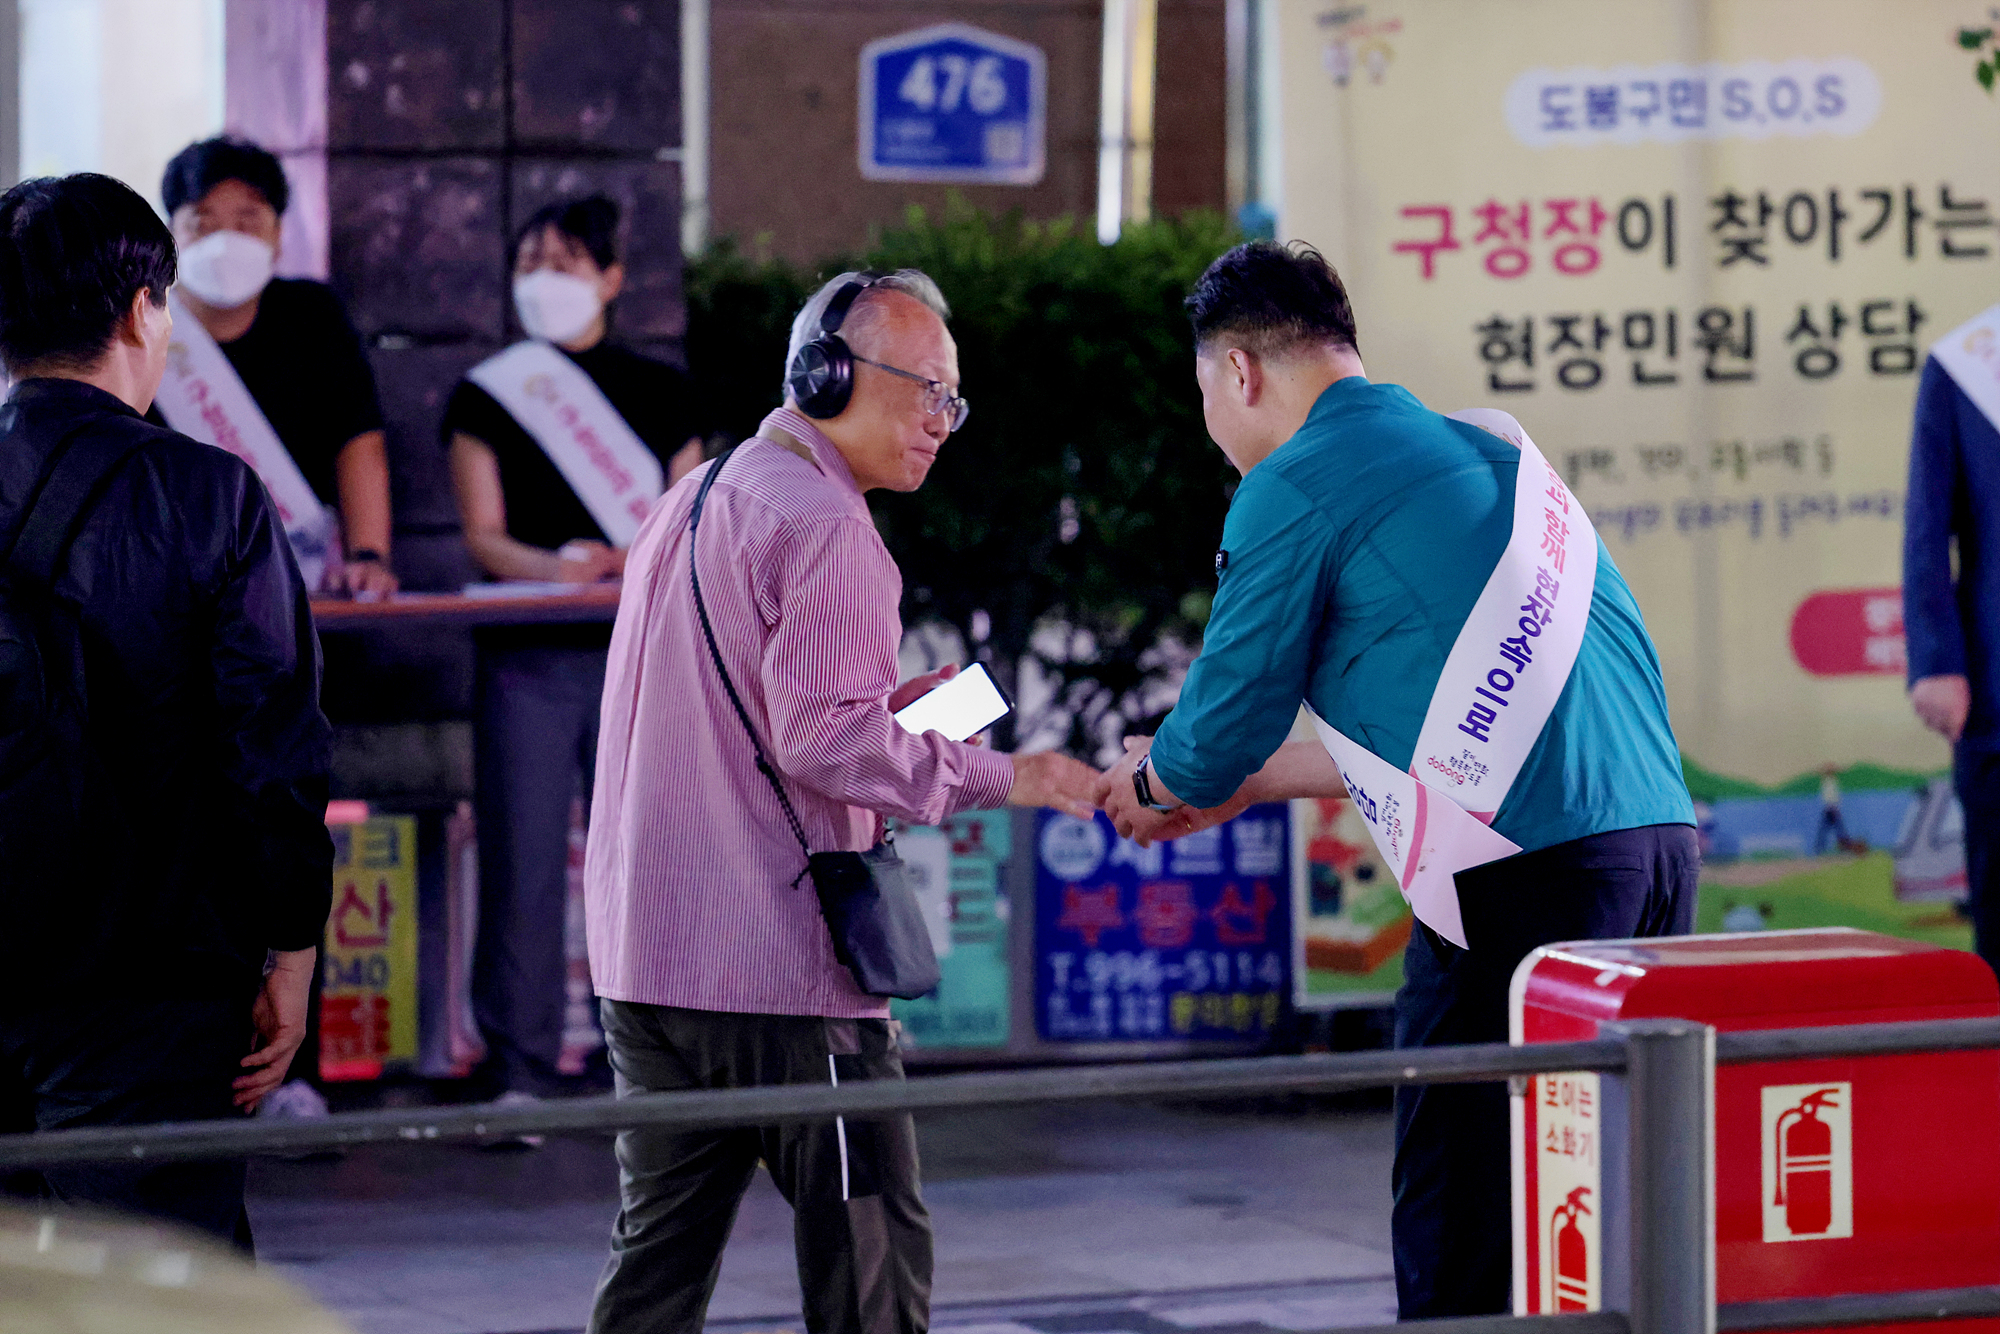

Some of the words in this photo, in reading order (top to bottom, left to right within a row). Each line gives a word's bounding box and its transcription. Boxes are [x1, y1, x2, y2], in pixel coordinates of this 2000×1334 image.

[900, 55, 1006, 114] 476
[1540, 83, 1707, 131] 도봉구민
[1393, 195, 1677, 280] 구청장이
[1709, 184, 1999, 268] 찾아가는
[1475, 304, 1756, 393] 현장민원
[1785, 298, 1930, 380] 상담
[1540, 506, 1570, 575] 함께
[1458, 565, 1560, 743] 현장속으로
[1427, 755, 1465, 785] dobong
[1056, 880, 1278, 947] 부동산
[1545, 1074, 1592, 1118] 보이는
[1545, 1123, 1594, 1167] 소화기
